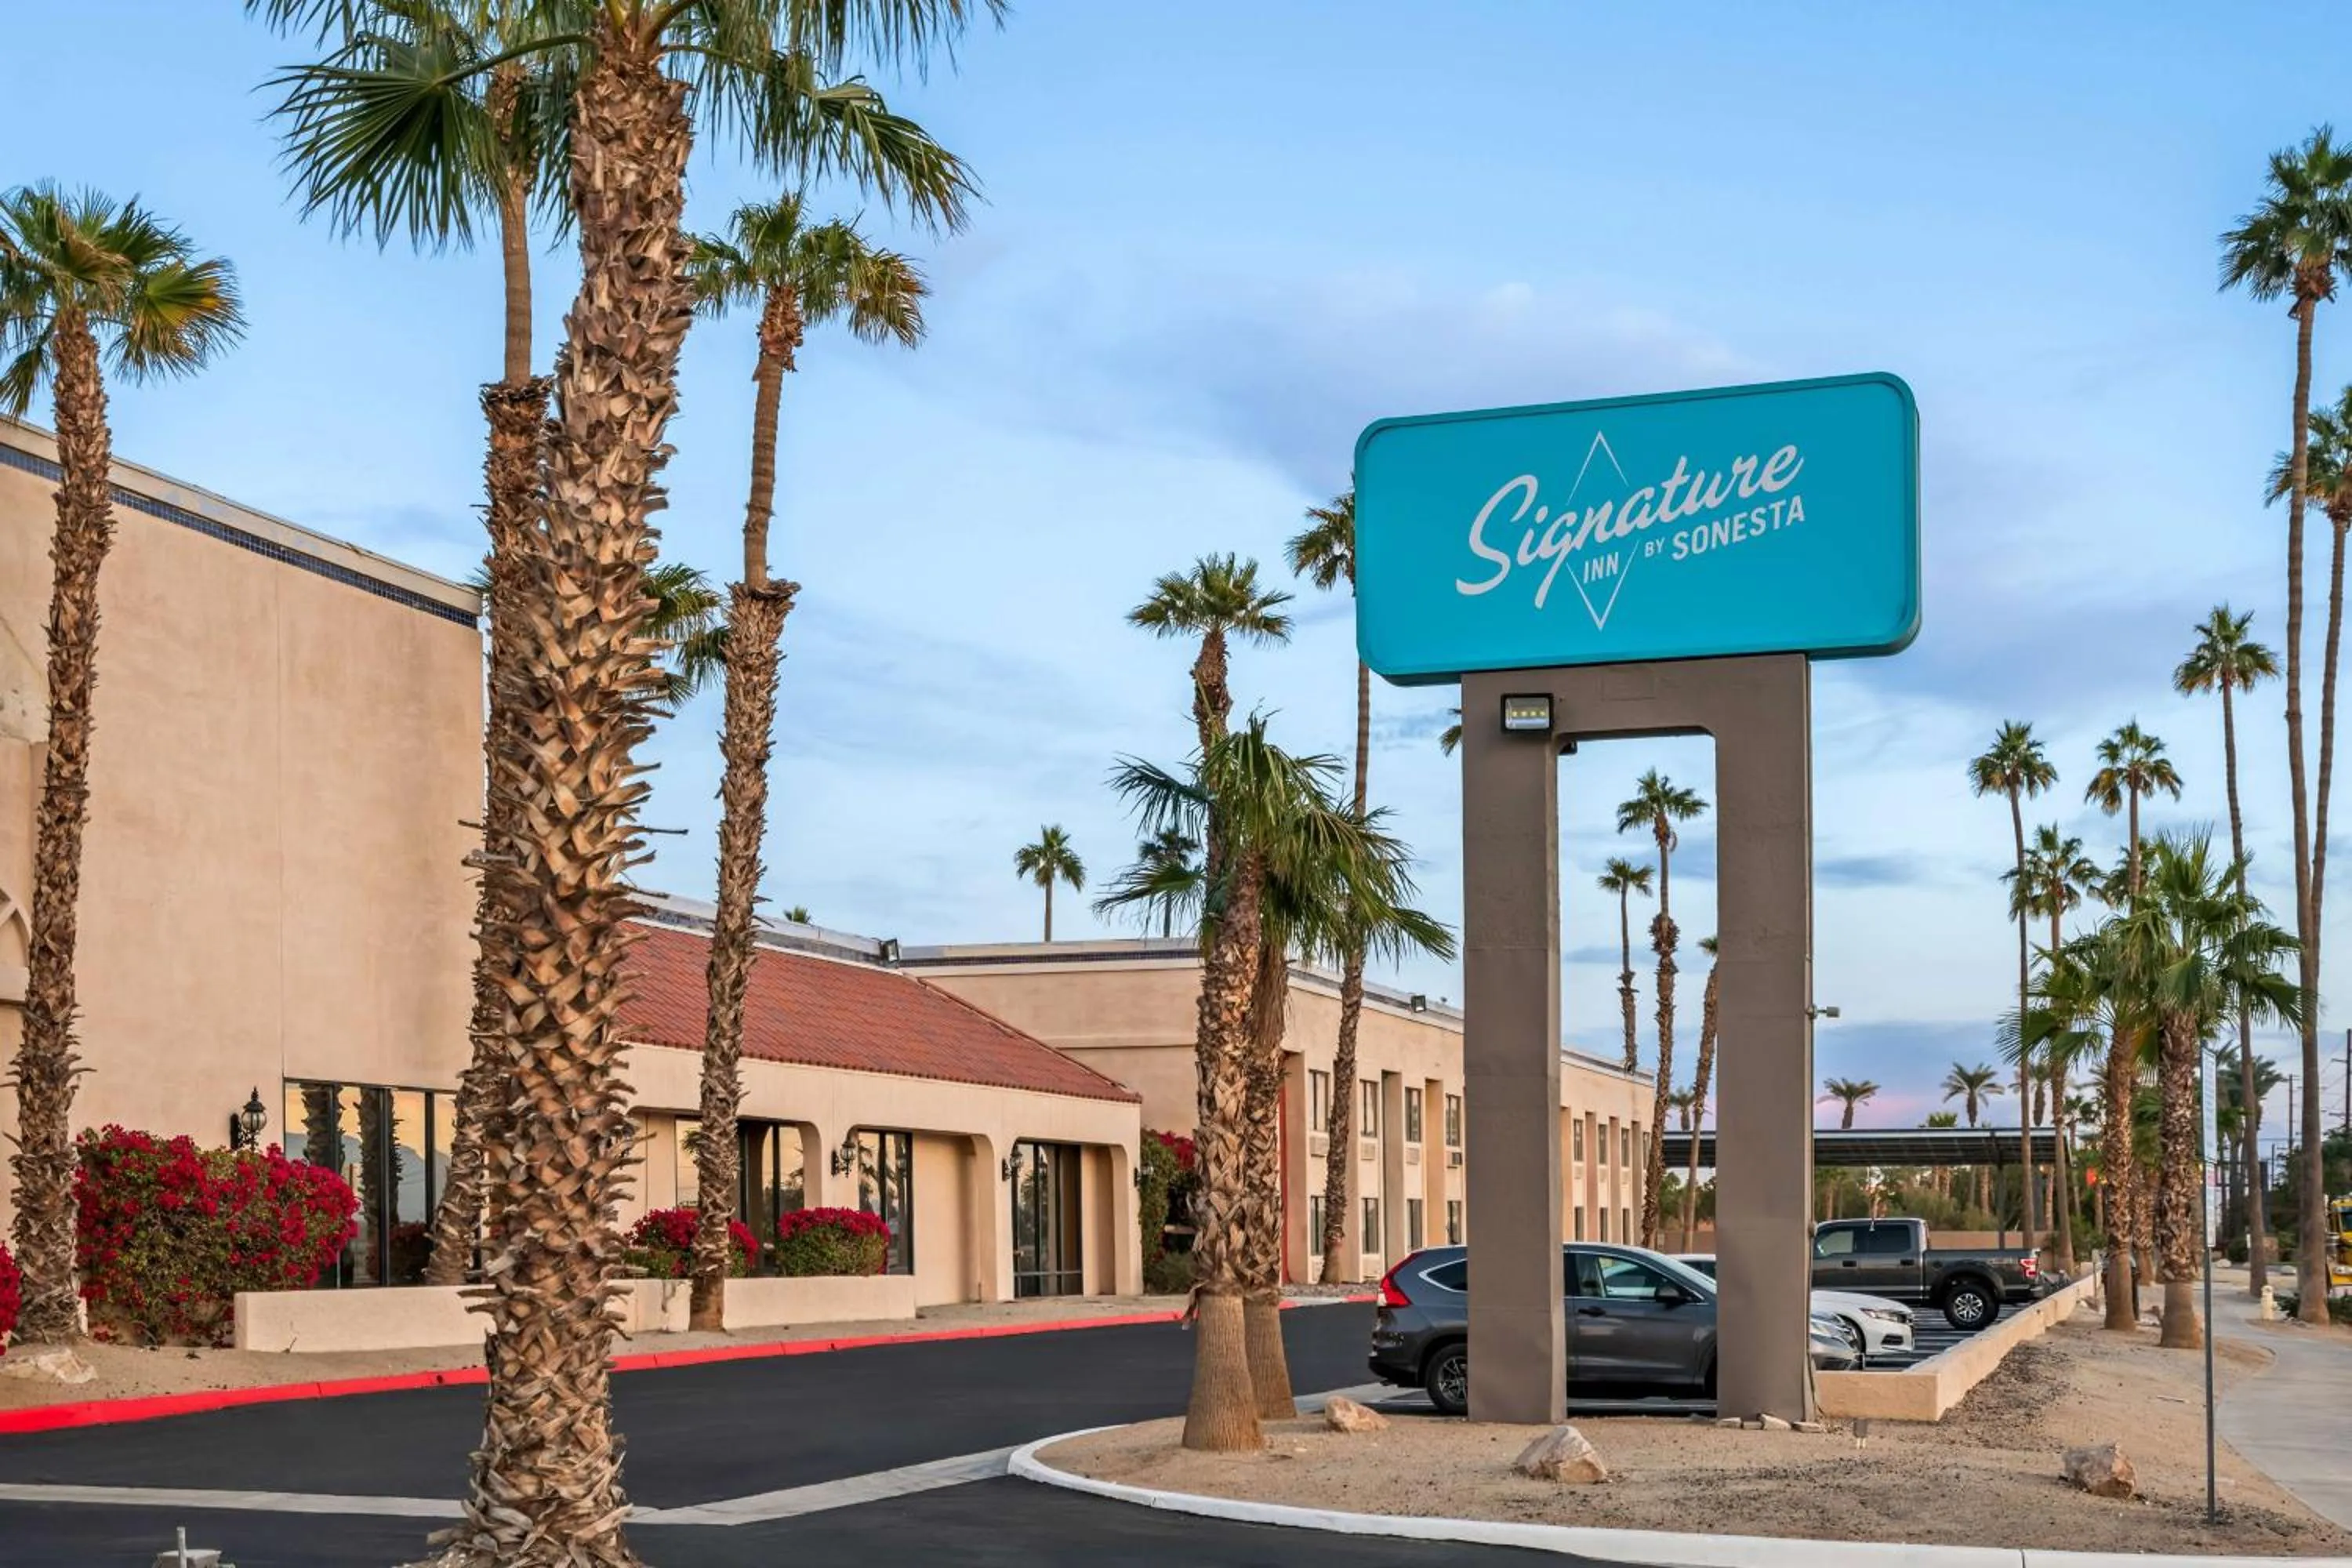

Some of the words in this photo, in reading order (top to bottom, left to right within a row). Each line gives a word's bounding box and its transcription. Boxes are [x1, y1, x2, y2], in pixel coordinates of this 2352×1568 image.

[1456, 445, 1804, 609] Signature
[1583, 552, 1619, 583] INN
[1645, 539, 1664, 557] BY
[1672, 495, 1806, 560] SONESTA
